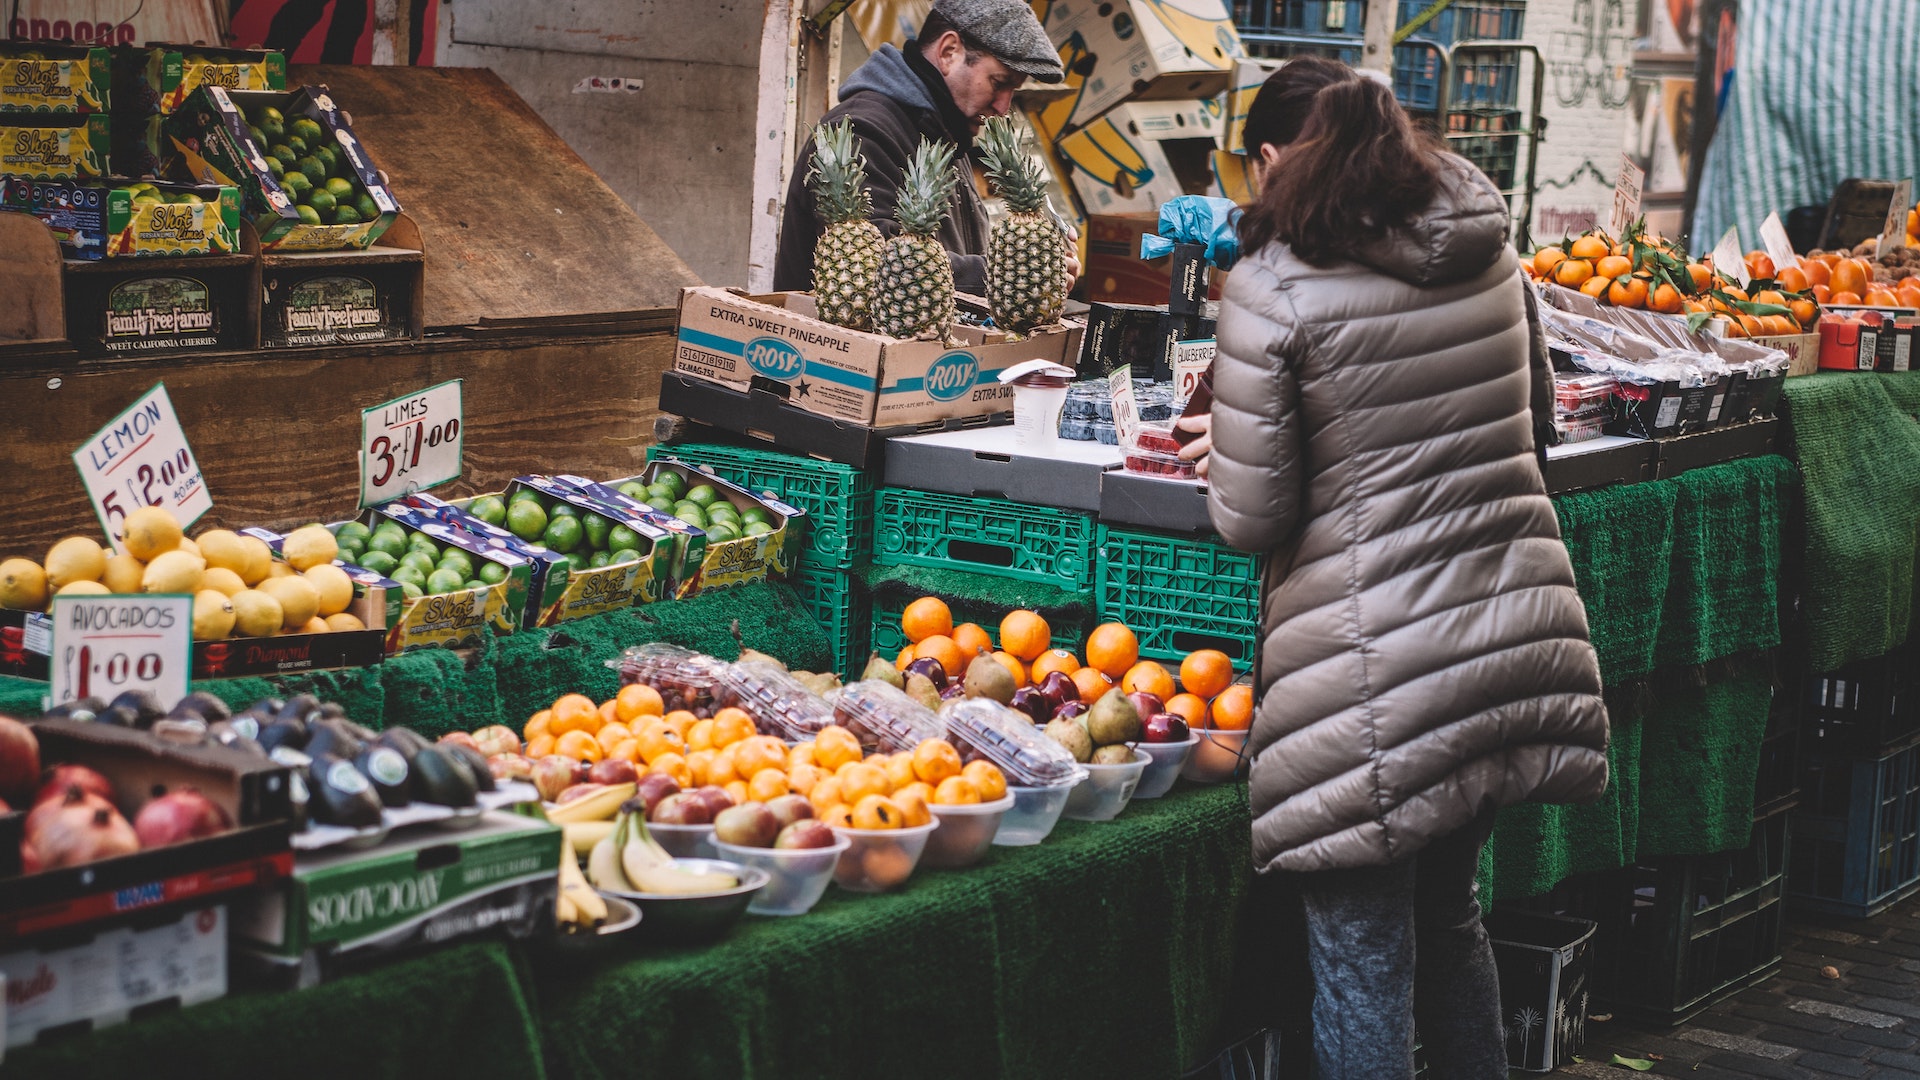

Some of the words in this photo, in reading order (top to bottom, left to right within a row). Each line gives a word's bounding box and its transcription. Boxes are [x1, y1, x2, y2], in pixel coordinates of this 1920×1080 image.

[15, 61, 59, 86] Shot
[201, 64, 239, 89] Shot
[15, 129, 59, 155] Shot
[150, 204, 193, 231] Shot
[106, 341, 132, 351] SWEET
[132, 339, 179, 350] CALIFORNIA
[180, 337, 217, 346] CHERRIES
[287, 334, 311, 347] SWEET
[709, 306, 746, 325] EXTRA
[747, 317, 787, 336] SWEET
[788, 327, 851, 353] PINEAPPLE
[750, 343, 797, 373] ROSY
[929, 363, 975, 391] ROSY
[972, 388, 997, 402] EXTRA
[384, 397, 428, 428] LIMES
[90, 400, 162, 471] LEMON
[370, 435, 395, 487] 3
[397, 418, 460, 477] £1.00
[102, 489, 127, 542] 5
[720, 537, 759, 567] Shot
[582, 568, 627, 599] Shot
[71, 604, 176, 631] AVOCADOS
[425, 590, 475, 623] Shot
[247, 637, 315, 664] Diamond
[62, 644, 164, 701] £1.00
[307, 867, 446, 932] AVOCADOS
